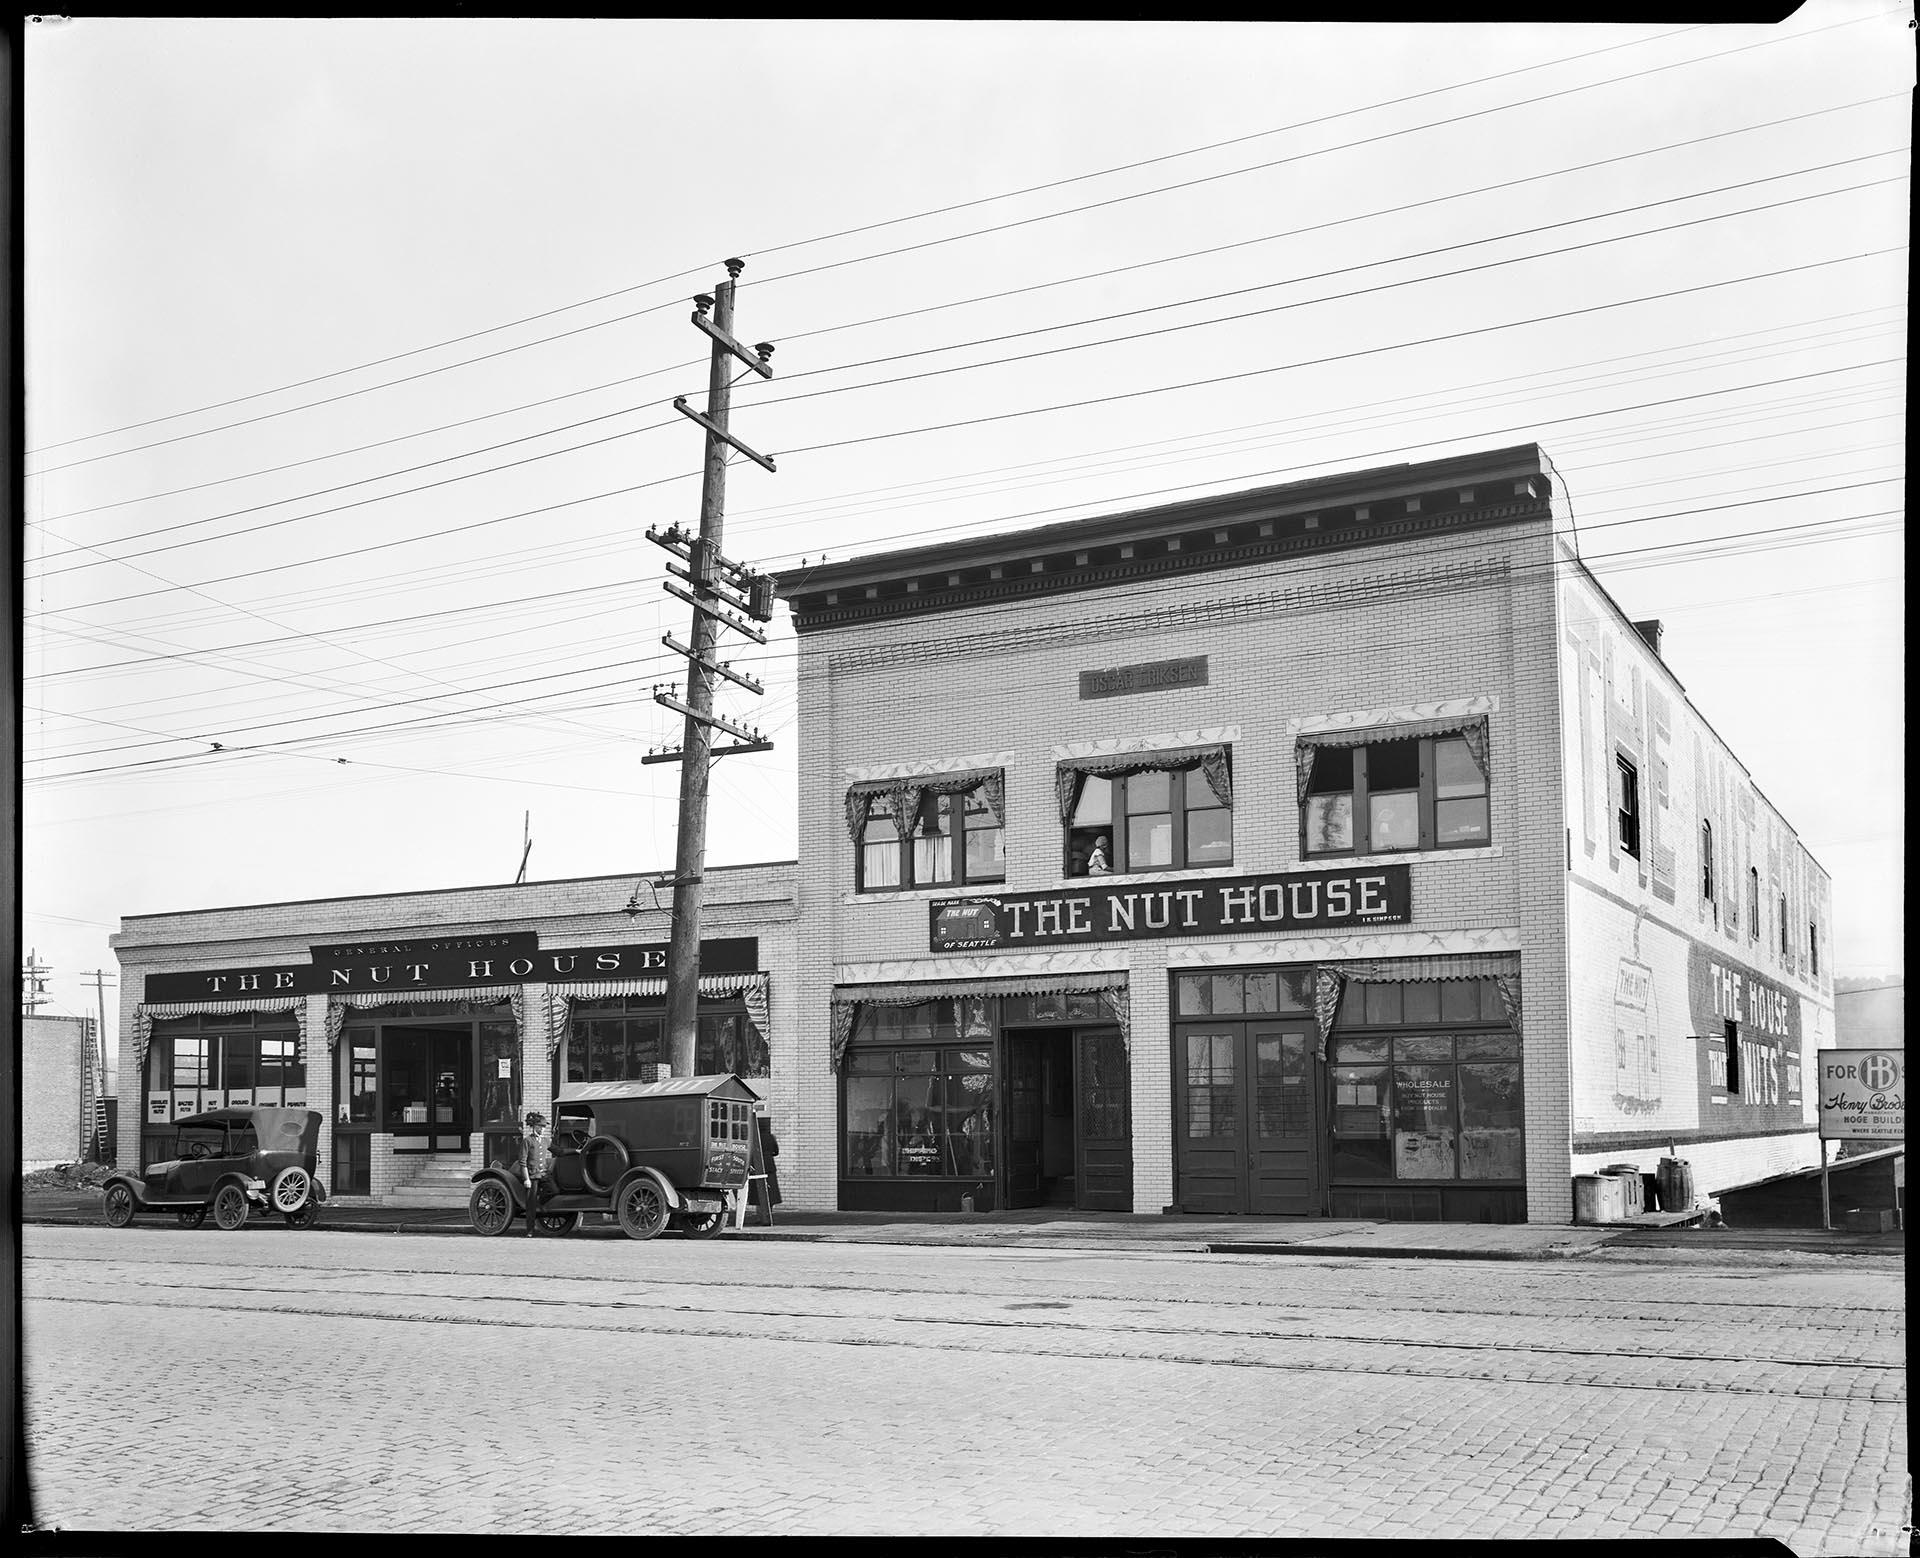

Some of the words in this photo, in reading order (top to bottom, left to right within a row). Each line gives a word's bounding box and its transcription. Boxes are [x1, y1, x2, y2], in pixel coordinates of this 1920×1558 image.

[946, 909, 960, 917] THE
[961, 908, 980, 917] NUT
[1003, 898, 1092, 938] THE
[1107, 889, 1204, 932] NUT
[1219, 876, 1388, 925] HOUSE
[334, 945, 412, 956] GENERAL
[431, 938, 510, 950] OFFICES
[957, 939, 997, 948] SEATTLE
[207, 972, 294, 993] THE
[331, 963, 429, 986] NUT
[468, 950, 667, 978] HOUSE
[1710, 962, 1743, 1022] THE
[1750, 980, 1789, 1036] HOUSE
[1827, 1065, 1857, 1079] FOR
[641, 1079, 715, 1095] NUT
[1396, 1081, 1451, 1089] WHOLESALE
[1824, 1092, 1868, 1114] Henry
[1844, 1116, 1868, 1124] HOGE
